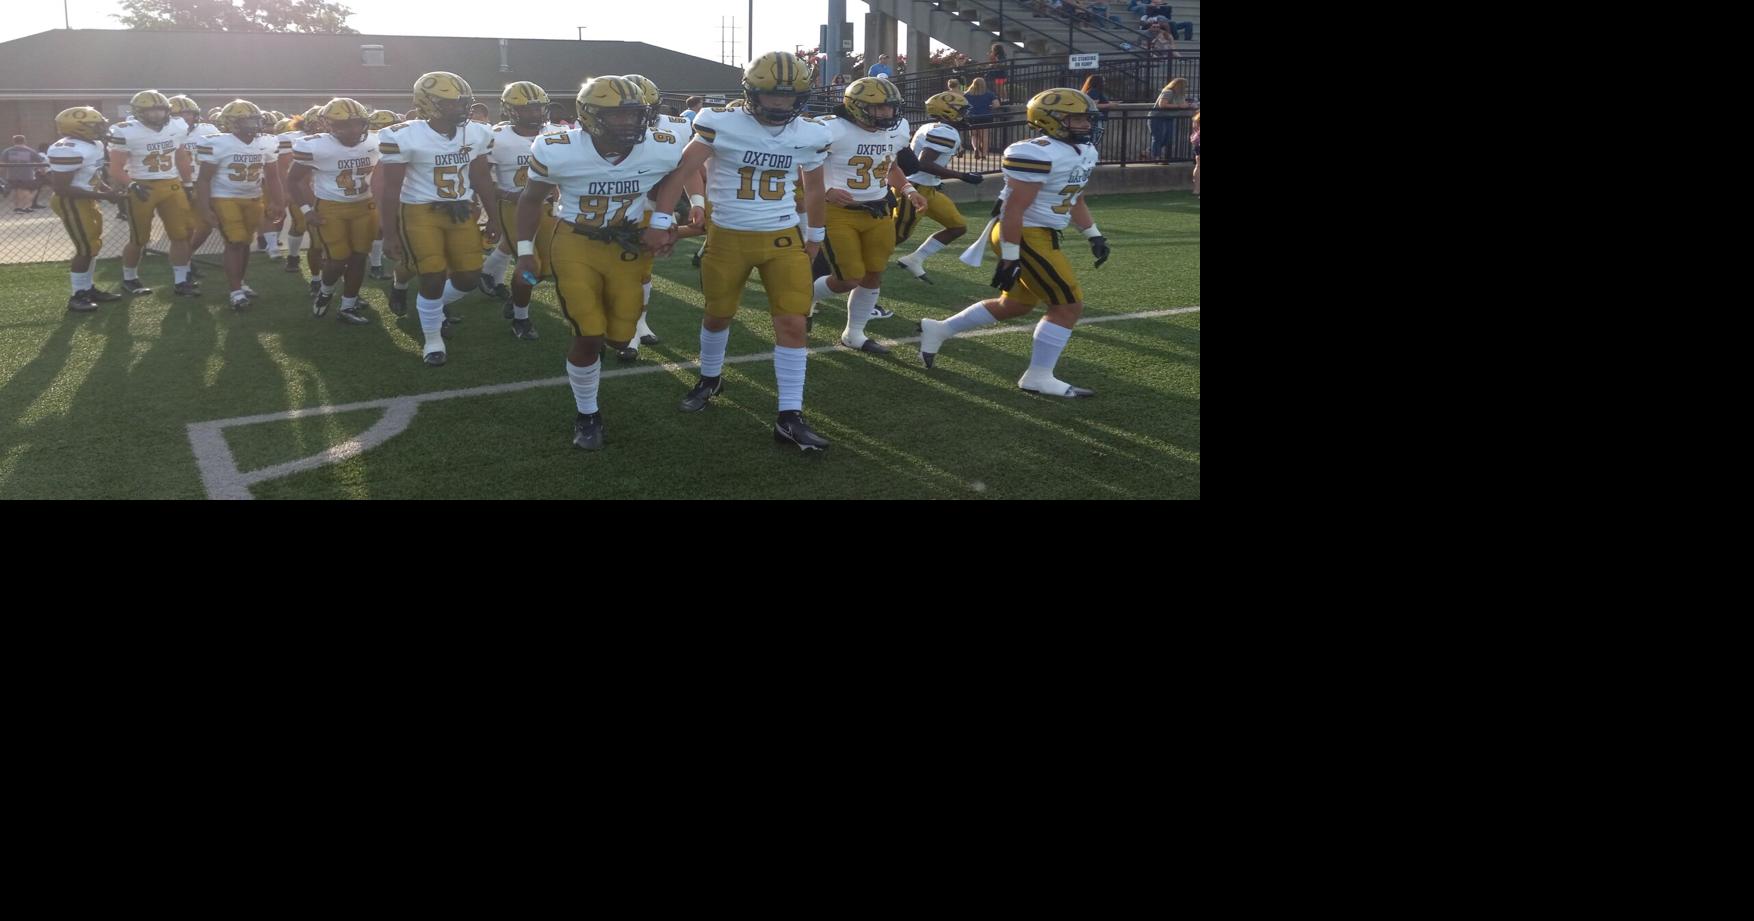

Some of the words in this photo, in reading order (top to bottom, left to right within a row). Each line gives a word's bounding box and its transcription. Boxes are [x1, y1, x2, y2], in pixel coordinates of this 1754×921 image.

[146, 140, 175, 152] OXFORD
[142, 147, 177, 173] 45
[233, 153, 263, 163] OXFORD
[337, 157, 371, 170] OXFORD
[434, 152, 470, 166] OXFORD
[742, 150, 793, 169] OXFORD
[846, 155, 891, 190] 34
[588, 179, 640, 195] OXFORD
[736, 166, 789, 200] 16
[575, 192, 642, 227] 97
